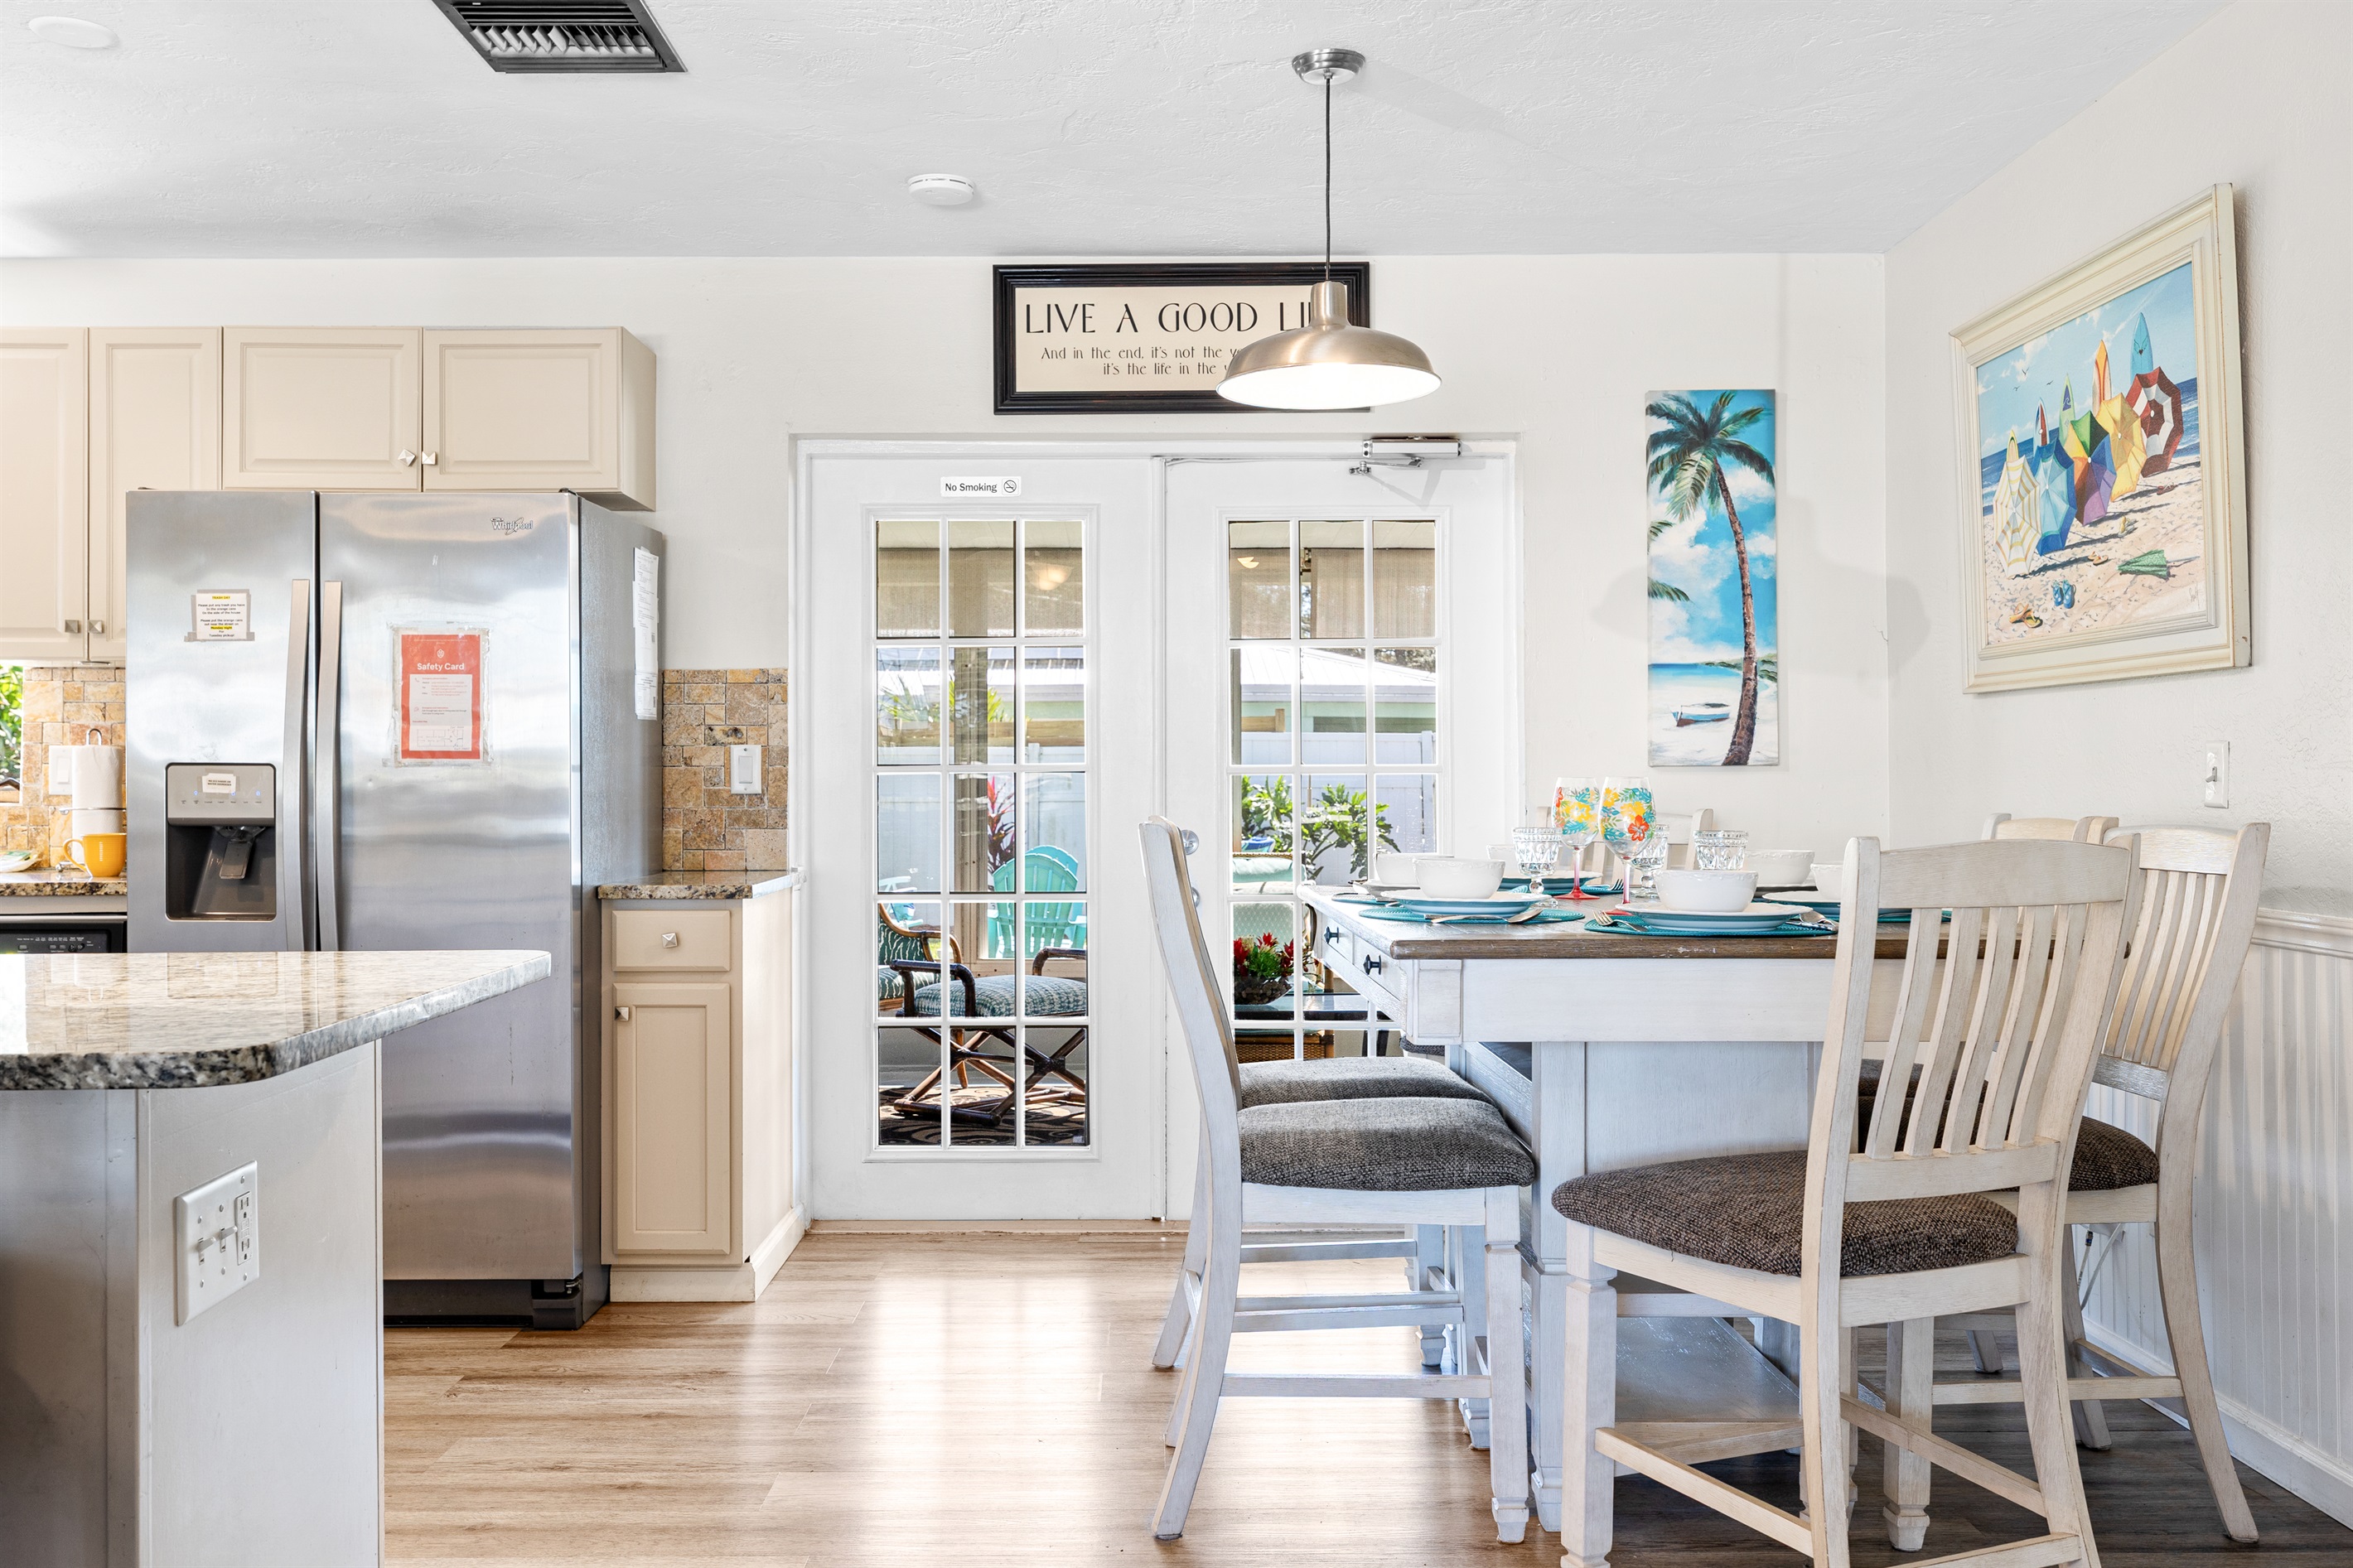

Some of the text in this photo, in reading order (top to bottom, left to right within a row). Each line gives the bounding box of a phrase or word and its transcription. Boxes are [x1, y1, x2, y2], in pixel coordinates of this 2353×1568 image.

[1026, 302, 1312, 333] LIVE A GOOD LI
[1041, 346, 1066, 359] And
[1073, 347, 1084, 359] in
[1091, 346, 1111, 359] the
[1119, 346, 1145, 360] end,
[1152, 346, 1167, 359] it's
[1175, 346, 1195, 359] not
[1203, 346, 1223, 358] the
[1104, 362, 1120, 375] it's
[1128, 362, 1148, 374] the
[1154, 362, 1172, 374] life
[1179, 362, 1190, 374] in
[1197, 362, 1217, 374] the
[945, 483, 998, 493] No Smoking
[417, 663, 443, 672] Safety
